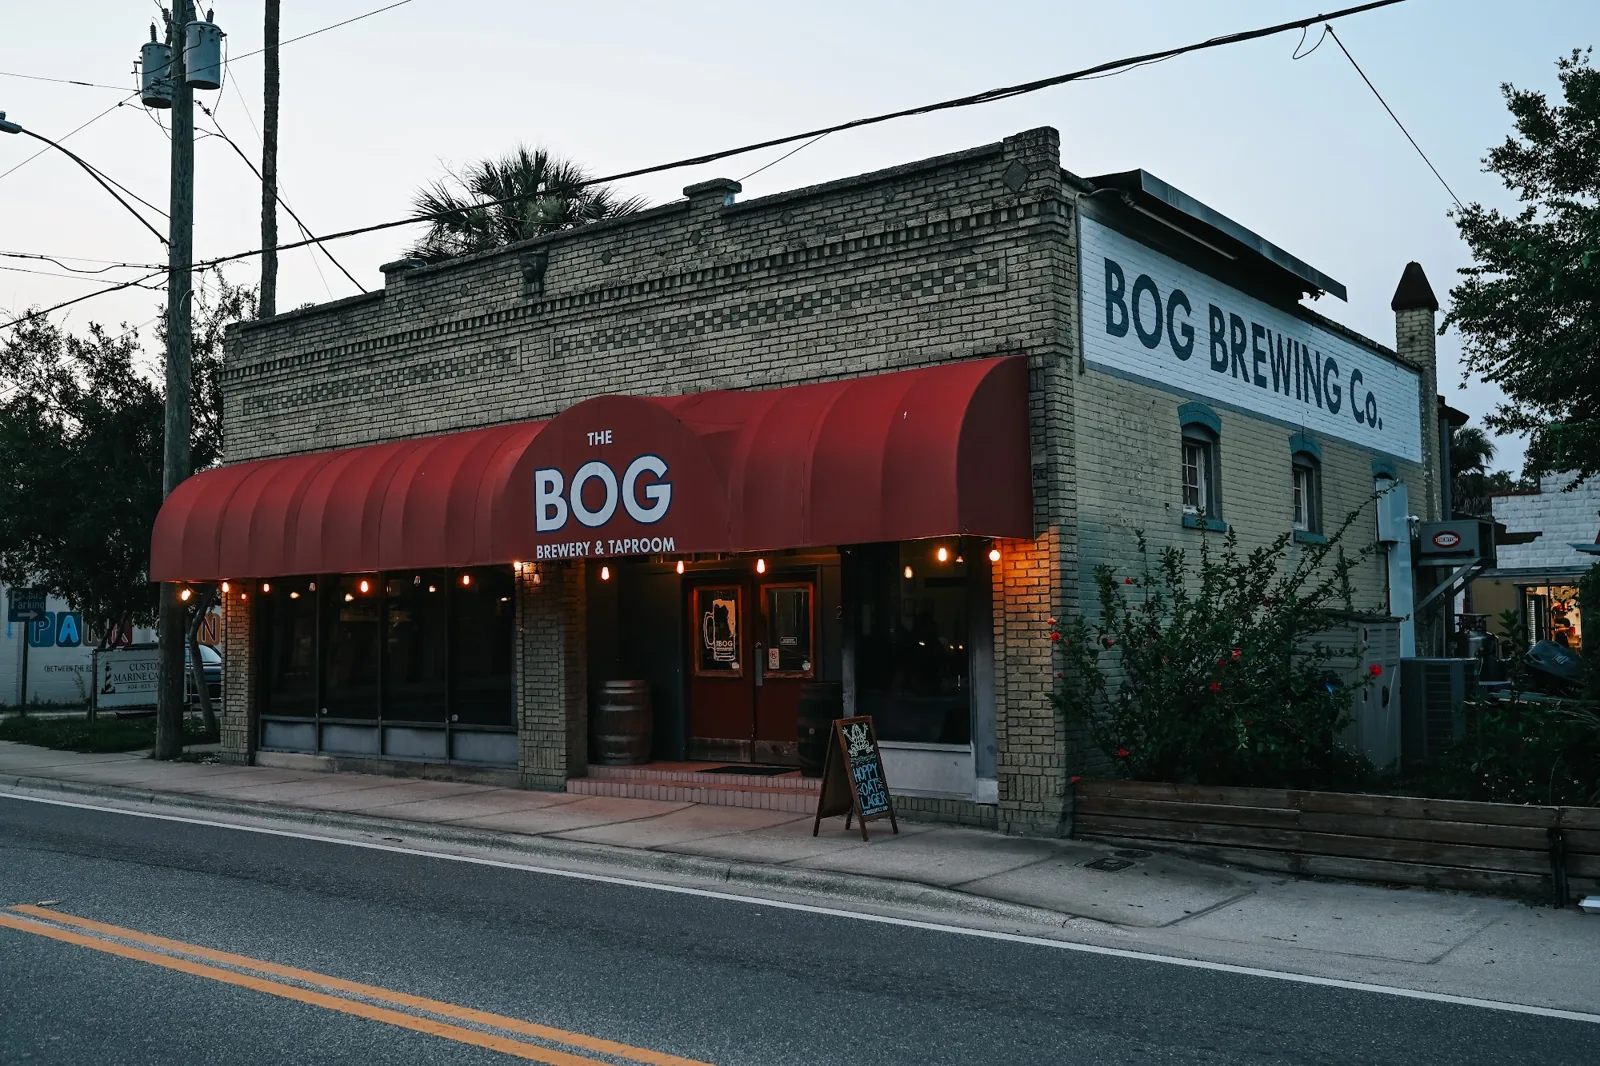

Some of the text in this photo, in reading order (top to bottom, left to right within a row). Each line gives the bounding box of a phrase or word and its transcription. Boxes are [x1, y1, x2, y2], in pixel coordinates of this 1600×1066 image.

[1104, 257, 1383, 430] BOG BREWING Co.
[587, 430, 613, 446] THE
[534, 455, 672, 532] BOG
[536, 536, 675, 559] BREWERY & TAPROOM
[113, 672, 147, 682] MARINE
[852, 762, 879, 783] HOPPY
[861, 777, 879, 796] OAT
[860, 791, 888, 810] LAGER
